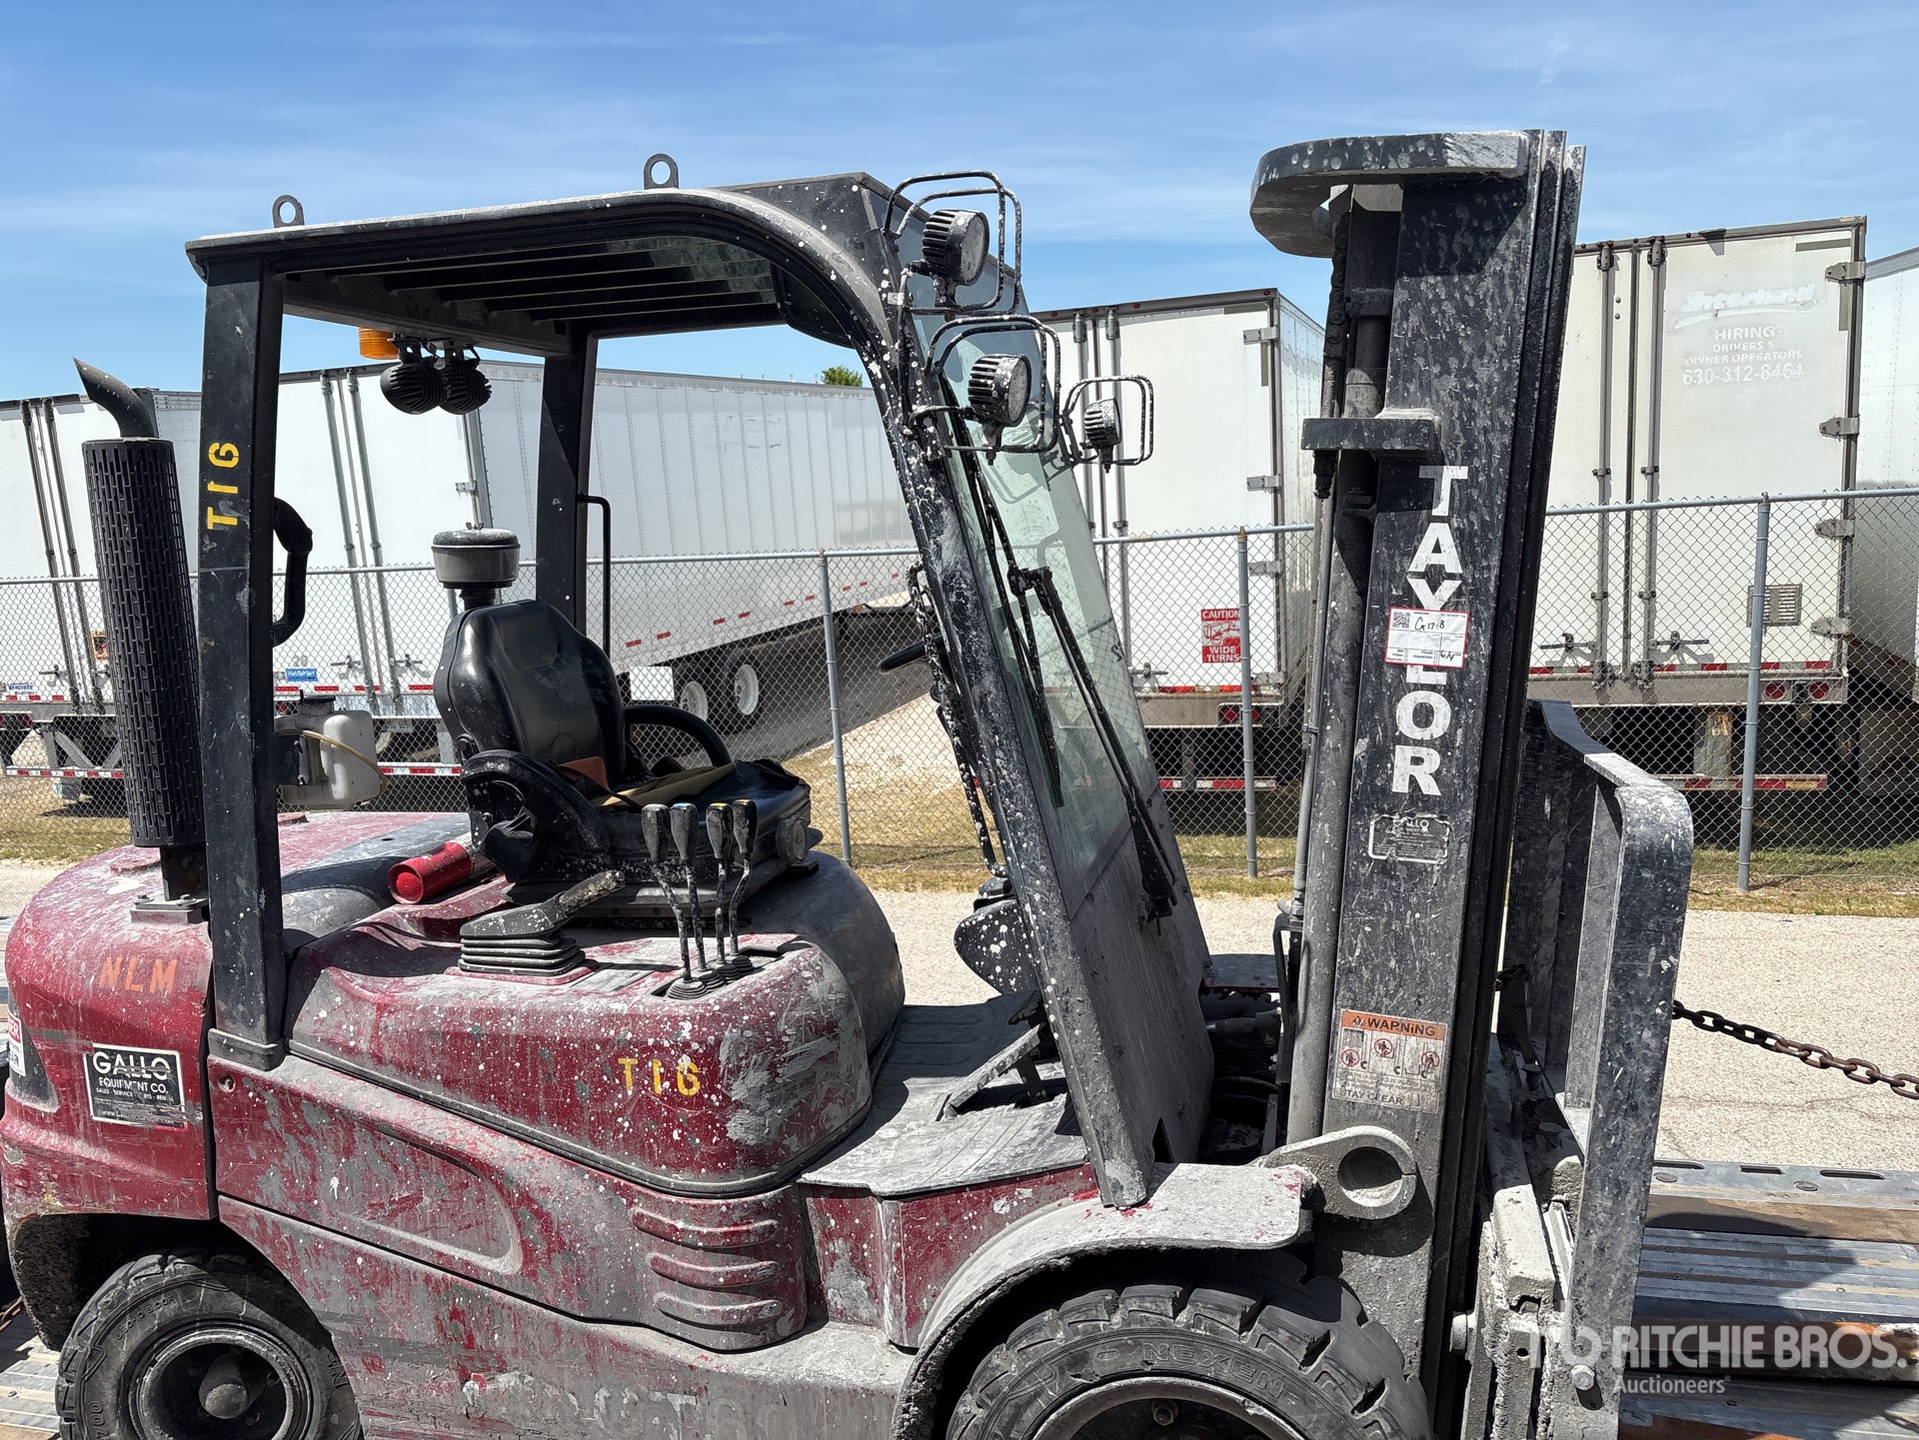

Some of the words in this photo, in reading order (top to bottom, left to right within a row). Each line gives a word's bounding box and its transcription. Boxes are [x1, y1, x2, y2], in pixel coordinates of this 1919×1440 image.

[1714, 325, 1775, 341] HIRING
[1712, 341, 1764, 353] DRIVERS
[1731, 350, 1803, 363] OPERATORS
[1682, 361, 1804, 386] 630-312-8464
[1202, 609, 1240, 619] CAUTION
[1209, 645, 1237, 654] WIDE
[1207, 654, 1240, 662] TURNS
[99, 956, 177, 993] NLM
[1368, 1017, 1436, 1036] WARNING
[92, 1051, 171, 1080] GALLO
[98, 1077, 148, 1091] EQUIPMNT
[150, 1082, 169, 1094] CO.
[1142, 1342, 1286, 1398] NEXEN
